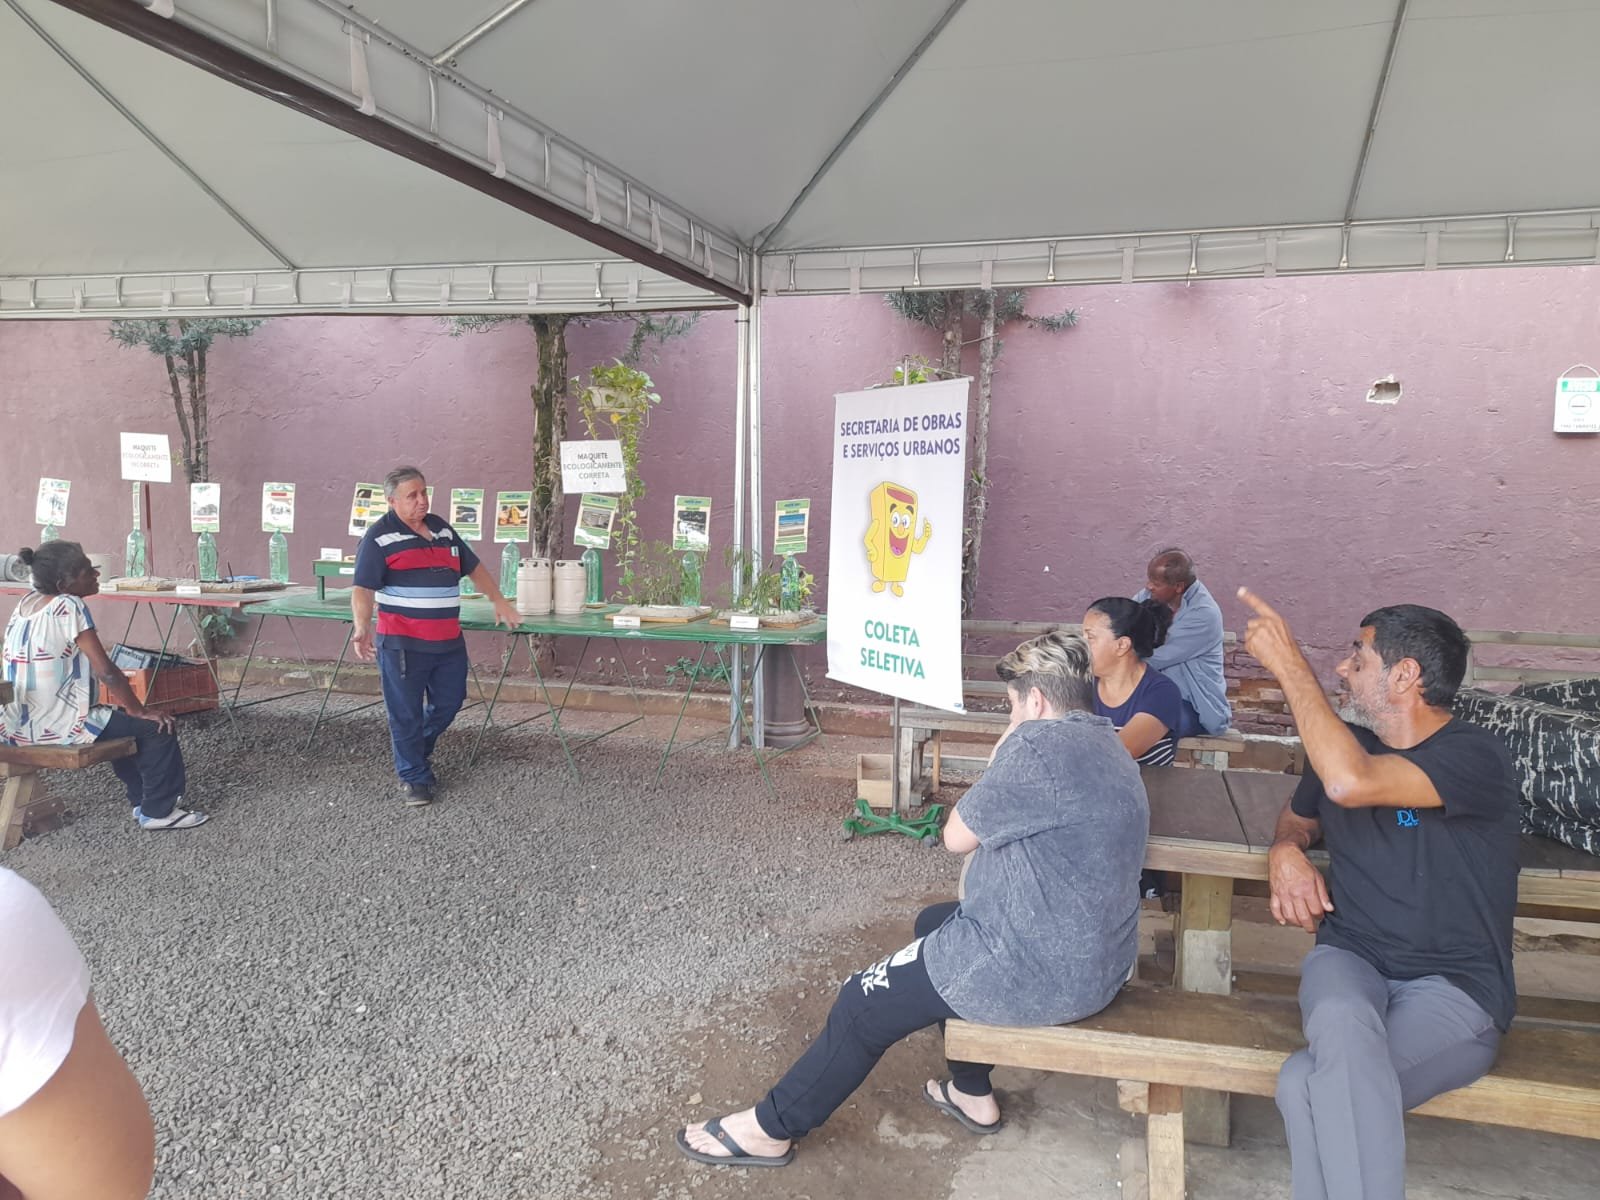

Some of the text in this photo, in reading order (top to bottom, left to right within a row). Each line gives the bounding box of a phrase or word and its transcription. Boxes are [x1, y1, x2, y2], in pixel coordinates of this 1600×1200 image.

[840, 412, 962, 437] SECRETARIA DE OBRAS
[577, 452, 608, 461] MAQUETE
[843, 438, 960, 461] E SERVIÇOS URBANOS
[563, 461, 622, 471] ECOLOGICAMENTE
[578, 471, 610, 479] CORRETA
[864, 619, 920, 647] COLETA
[860, 647, 926, 679] SELETIVA
